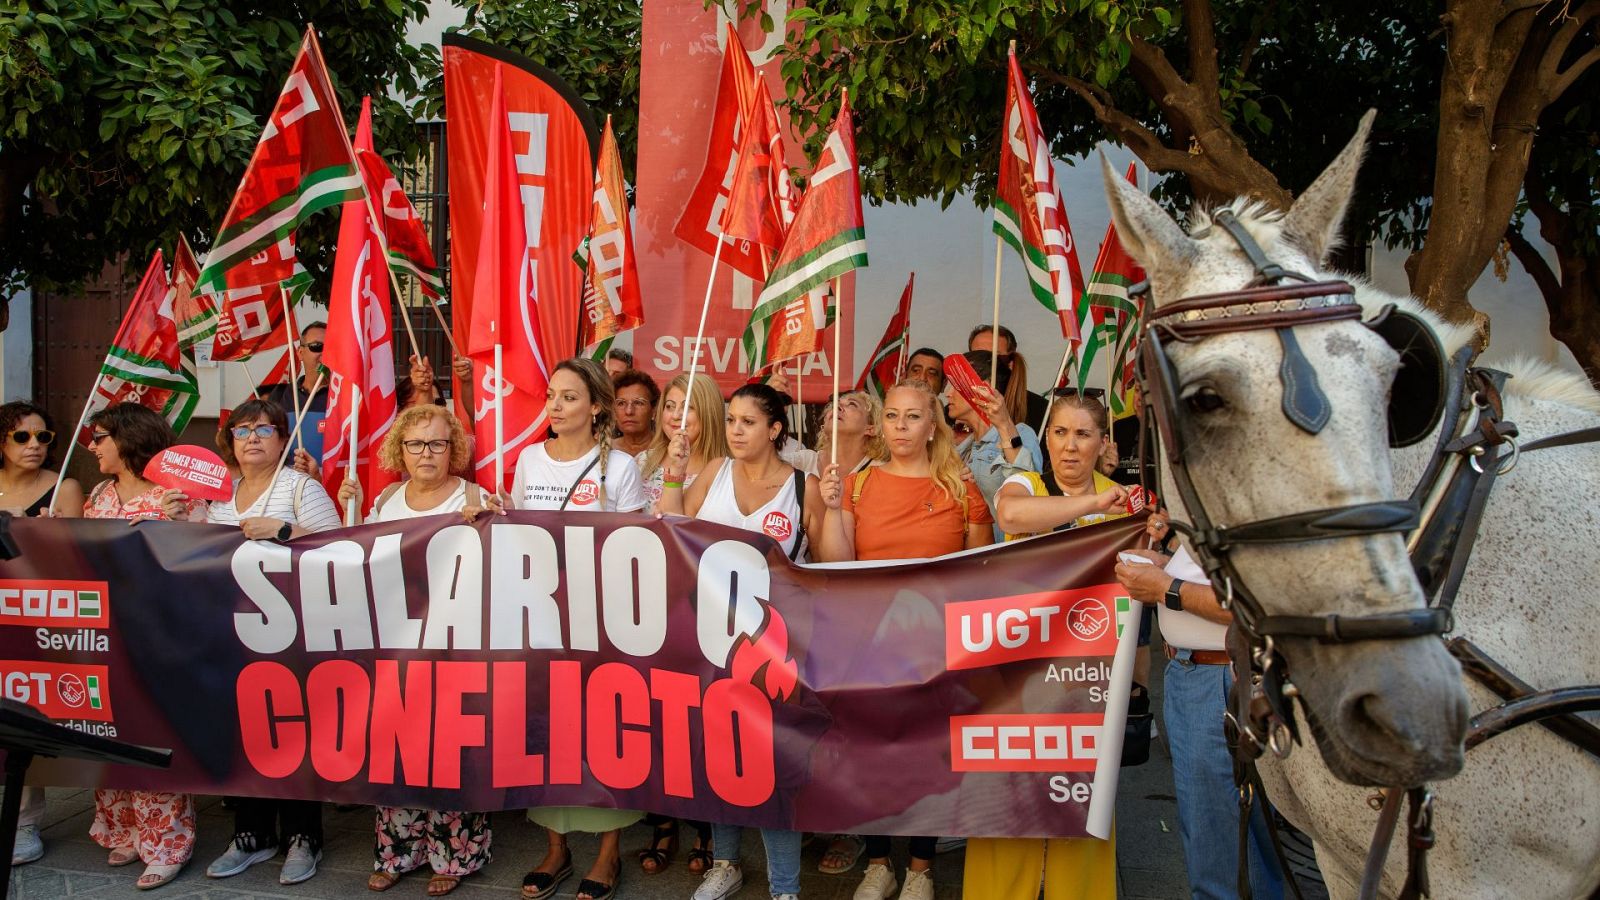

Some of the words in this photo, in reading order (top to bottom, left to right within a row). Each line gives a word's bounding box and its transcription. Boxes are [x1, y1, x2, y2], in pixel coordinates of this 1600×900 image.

[653, 335, 833, 377] SEVIA
[162, 449, 190, 468] PRIMER
[190, 457, 228, 479] SINDICATO
[574, 483, 597, 495] UGT
[766, 513, 789, 531] UGT
[0, 588, 76, 618] COO
[231, 523, 667, 657] SALARIO
[697, 540, 771, 669] O
[35, 627, 110, 652] Sevilla
[961, 606, 1060, 652] UGT
[0, 671, 51, 705] GT
[1044, 662, 1112, 682] Andalu
[236, 659, 776, 808] CONFLICTO
[962, 726, 1103, 760] CCOO
